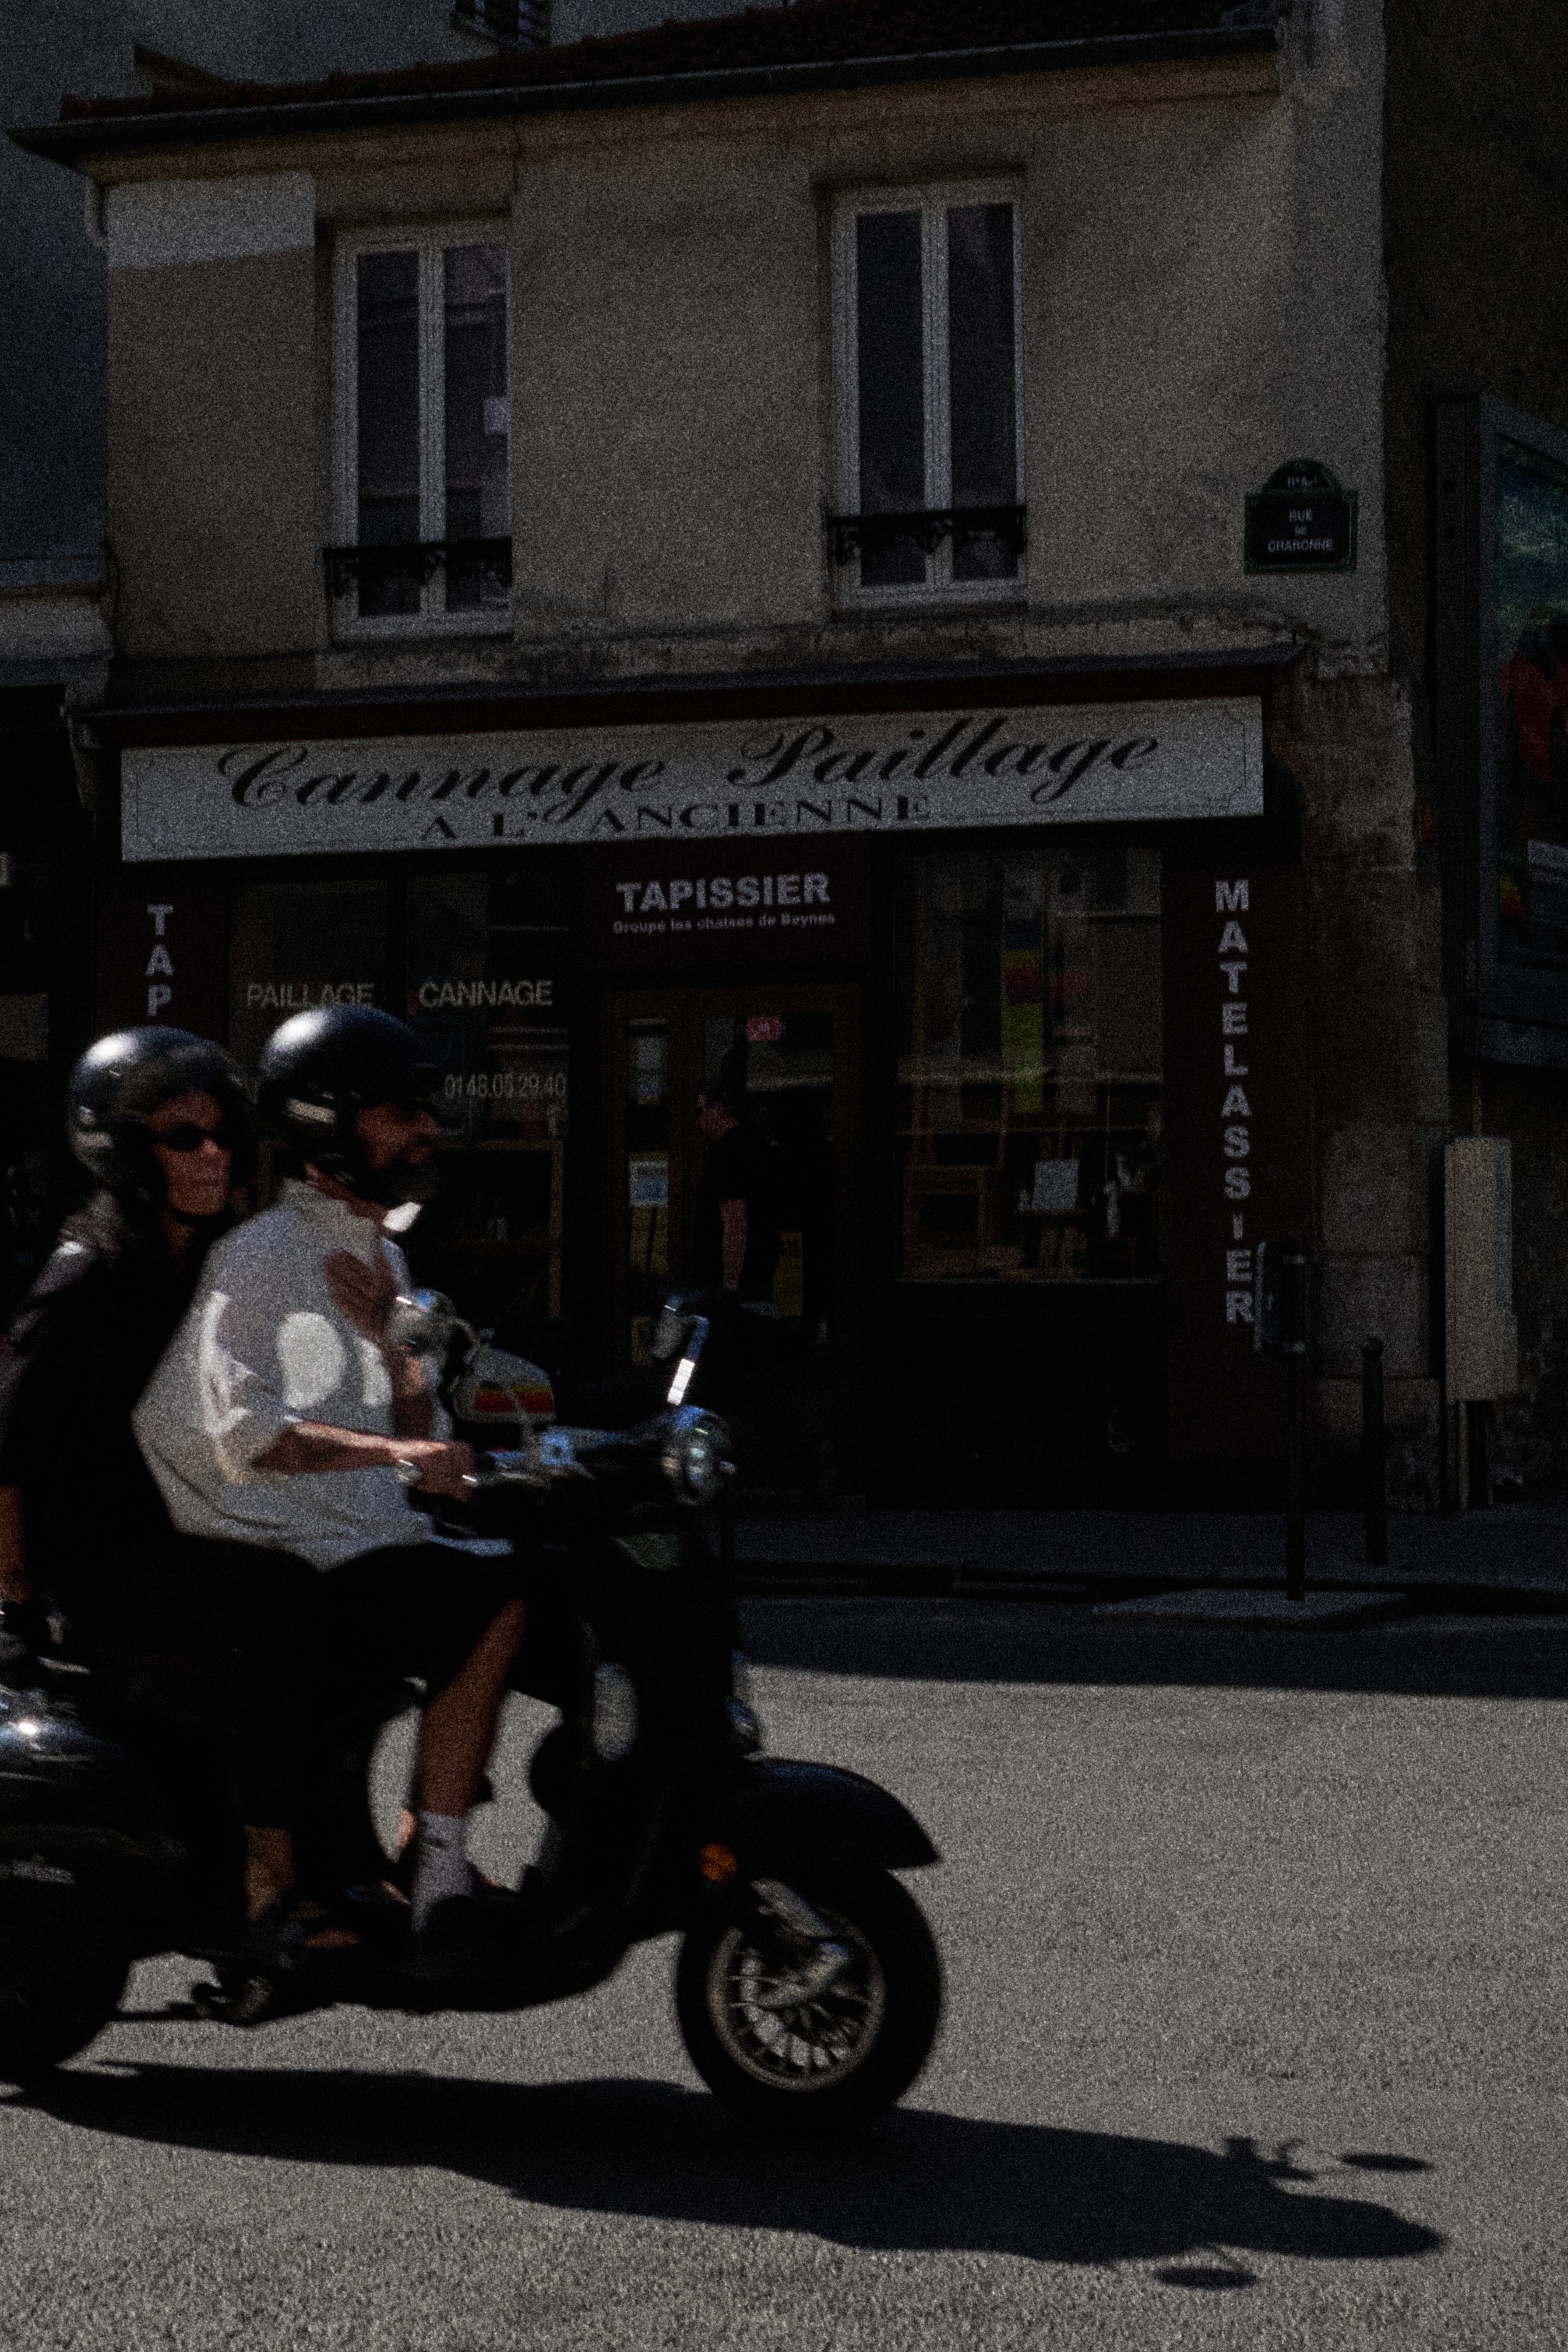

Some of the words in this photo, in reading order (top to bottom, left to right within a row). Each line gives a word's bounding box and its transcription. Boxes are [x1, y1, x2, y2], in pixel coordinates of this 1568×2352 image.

[1288, 508, 1313, 522] RUE
[1294, 525, 1307, 536] DE
[1267, 537, 1334, 553] CHARONNE
[217, 747, 665, 823] Cannage
[727, 717, 1158, 804] Paillage
[422, 816, 456, 840] A
[615, 871, 831, 913] TAPISSIER
[758, 913, 776, 927] de
[246, 982, 375, 1009] PAILLAGE
[418, 980, 554, 1008] CANNAGE
[1214, 878, 1255, 1325] MATELASSIER
